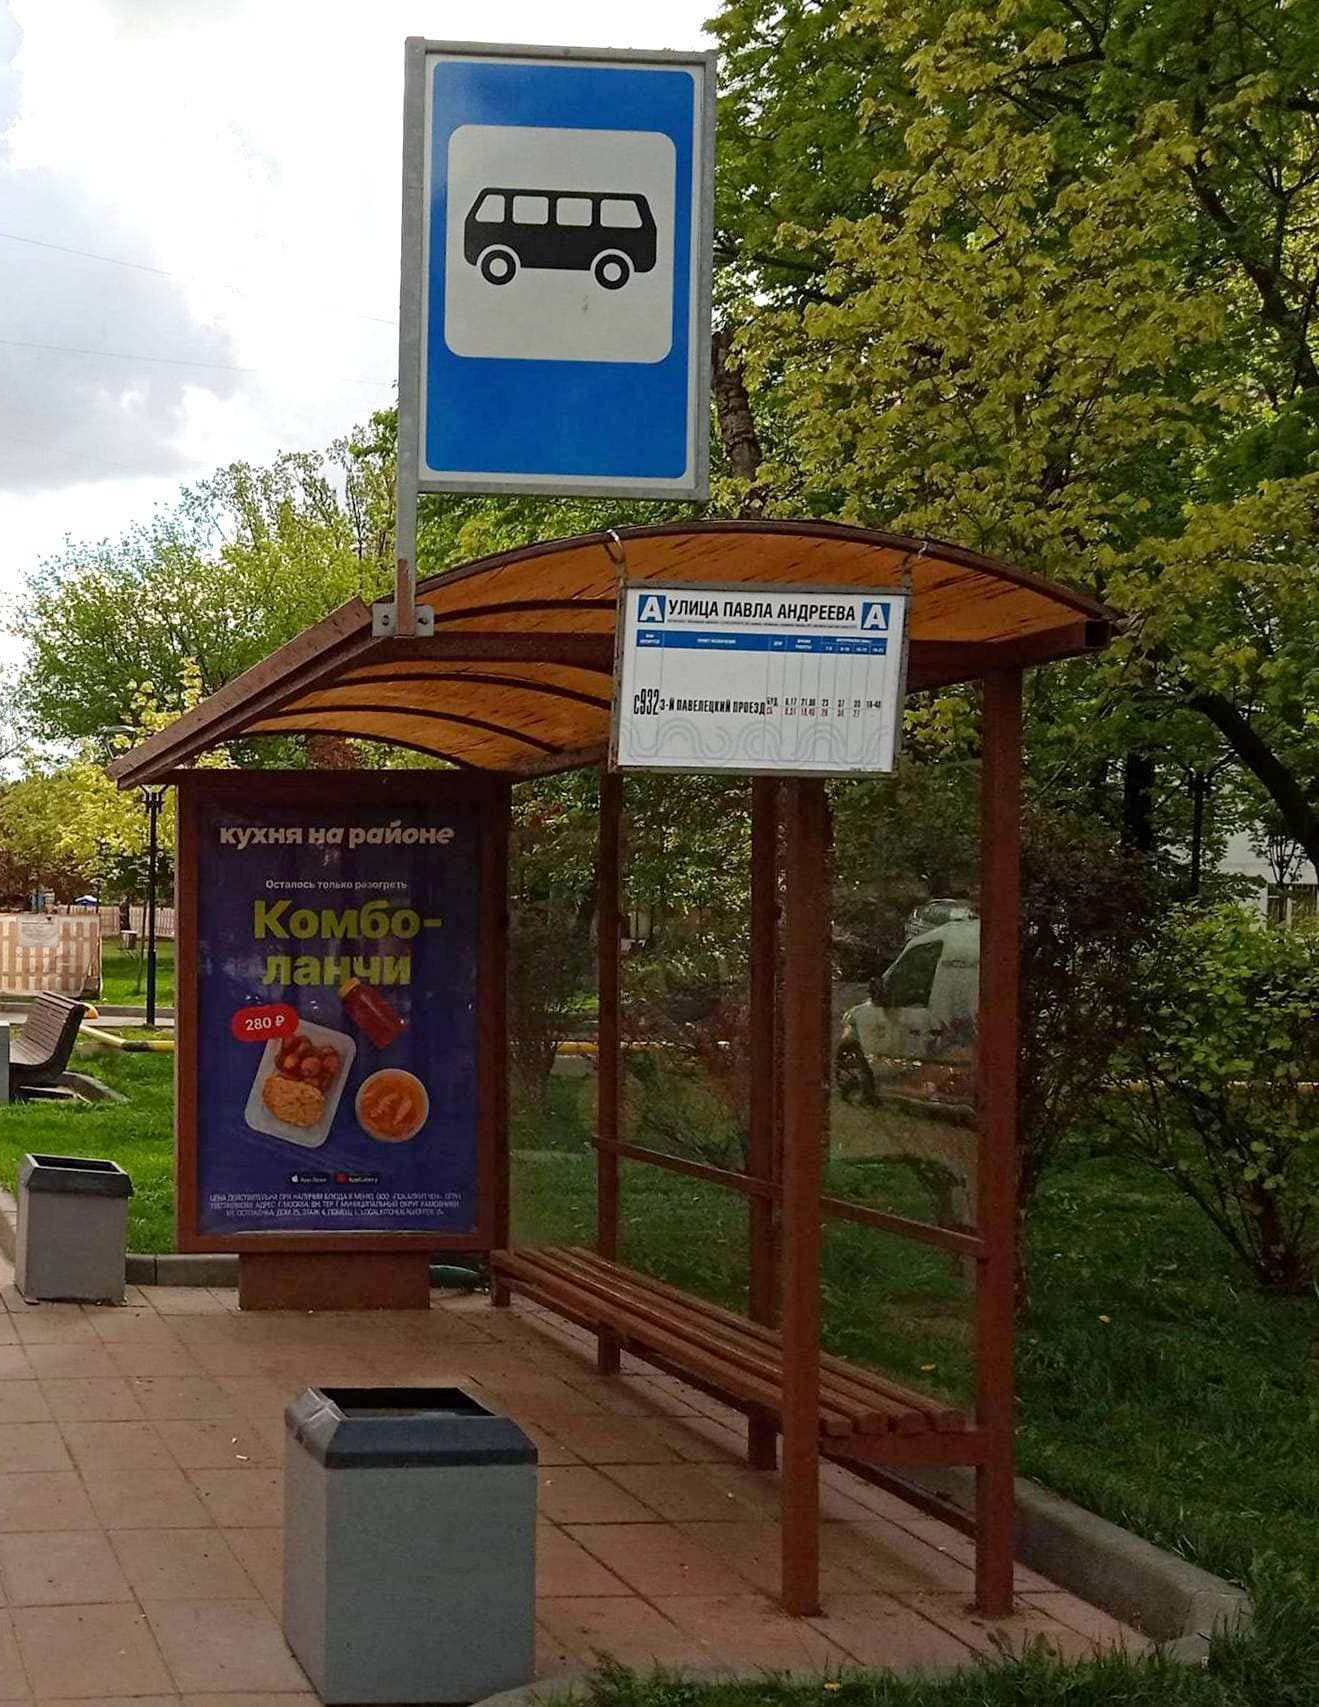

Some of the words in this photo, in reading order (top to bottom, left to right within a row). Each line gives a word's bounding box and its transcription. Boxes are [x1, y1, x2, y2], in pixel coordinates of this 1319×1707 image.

[669, 599, 719, 619] УЛИЦА
[723, 602, 773, 619] ПАВЛА
[777, 604, 856, 622] АНДРЕЕВА
[676, 698, 731, 714] ПАВЕЛЕЦКИЙ
[733, 701, 766, 716] ПРОЕЗД
[220, 826, 303, 850] кухня
[308, 826, 345, 844] на
[349, 820, 454, 849] районе
[265, 879, 315, 889] Осталось
[317, 880, 353, 889] только
[355, 880, 408, 891] разогреть
[254, 899, 442, 939] Комбо-
[263, 955, 411, 985] ланчи
[245, 1017, 272, 1031] 280
